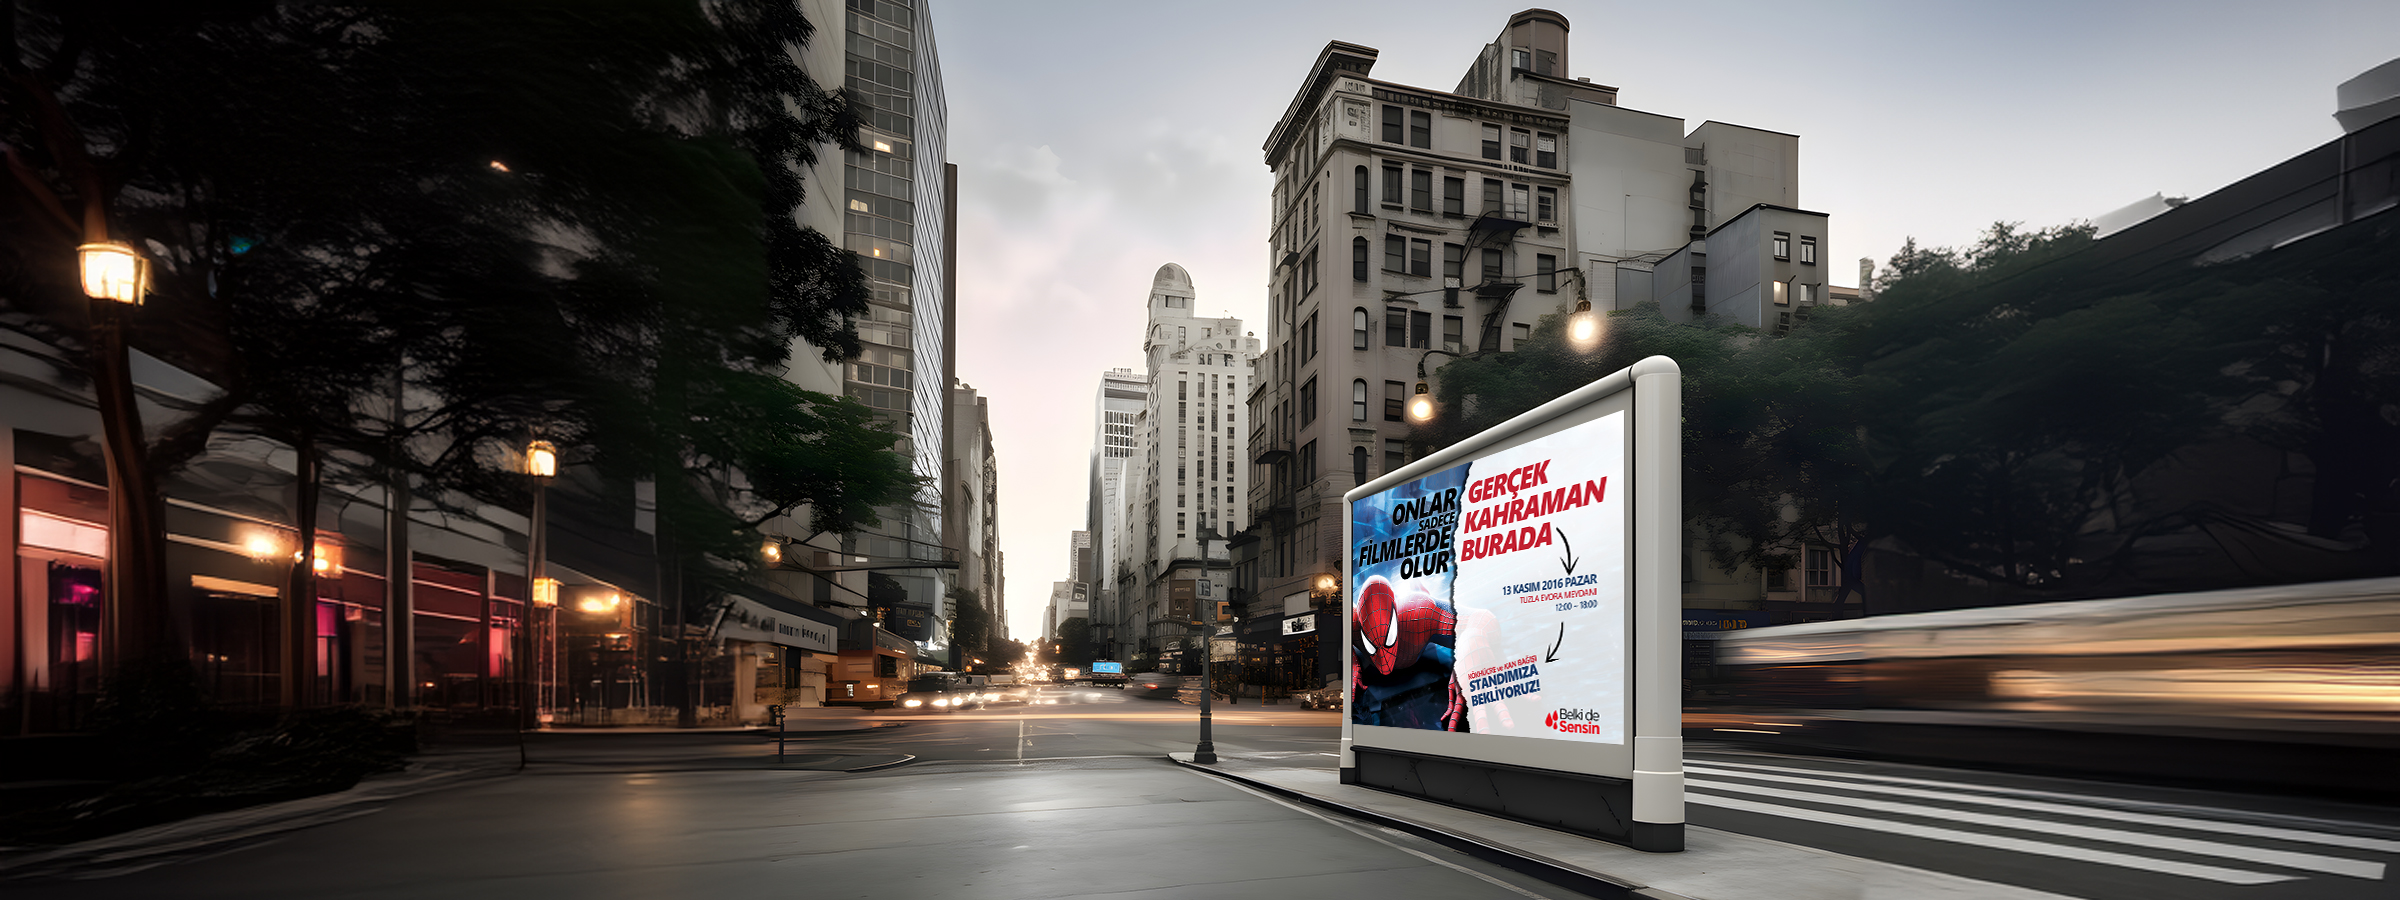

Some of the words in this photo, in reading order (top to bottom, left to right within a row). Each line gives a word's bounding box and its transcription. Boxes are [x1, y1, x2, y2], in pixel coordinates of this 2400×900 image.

[1468, 459, 1551, 503] GERÇEK
[1392, 488, 1457, 525] ONLAR
[1464, 476, 1608, 534] KAHRAMAN
[1418, 512, 1455, 531] SADECE
[1359, 525, 1451, 567] FİLMLERDE
[1461, 522, 1552, 562] BURADA
[1400, 551, 1449, 580] OLUR
[1502, 585, 1511, 595] 13
[1513, 581, 1540, 594] KASIM
[1542, 578, 1563, 590] 2016
[1565, 574, 1597, 587] PAZAR
[1520, 594, 1539, 603] TUZLA
[1541, 592, 1563, 601] EVORA
[1564, 588, 1597, 598] MEYDANI
[1469, 663, 1539, 692] STANDIMIZA
[1504, 661, 1517, 669] KAN
[1471, 679, 1540, 707] BEKLİYORUZ!
[1559, 708, 1583, 721] Belki
[1585, 709, 1600, 721] de
[1559, 720, 1600, 735] Sensin
